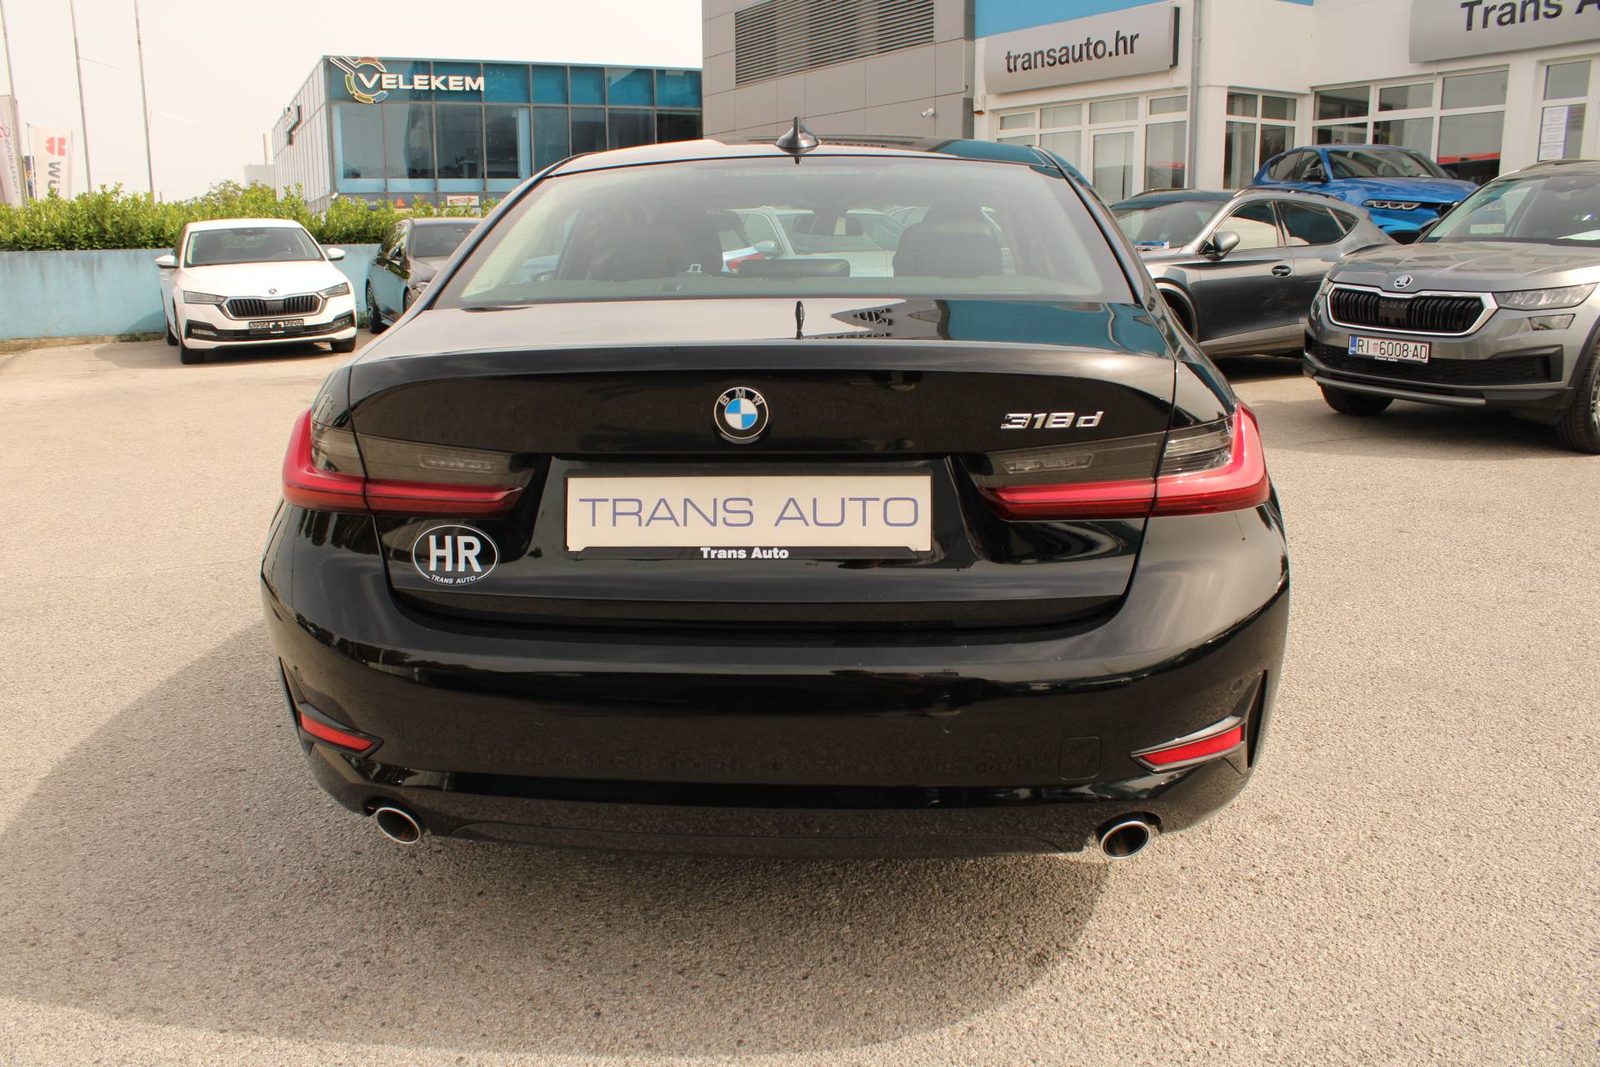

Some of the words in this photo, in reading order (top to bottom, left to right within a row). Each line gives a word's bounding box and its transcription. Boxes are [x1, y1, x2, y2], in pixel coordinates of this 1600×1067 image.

[1460, 0, 1563, 31] Trans
[1005, 30, 1140, 73] transauto.hr
[357, 73, 485, 92] VELEKEM
[719, 387, 764, 407] BMW
[579, 497, 754, 527] TRANS
[774, 496, 919, 527] AUTO
[429, 534, 482, 572] HR
[700, 547, 747, 559] Trans
[751, 547, 789, 559] Auto
[431, 574, 454, 584] TRANS
[456, 575, 476, 584] AUTO
